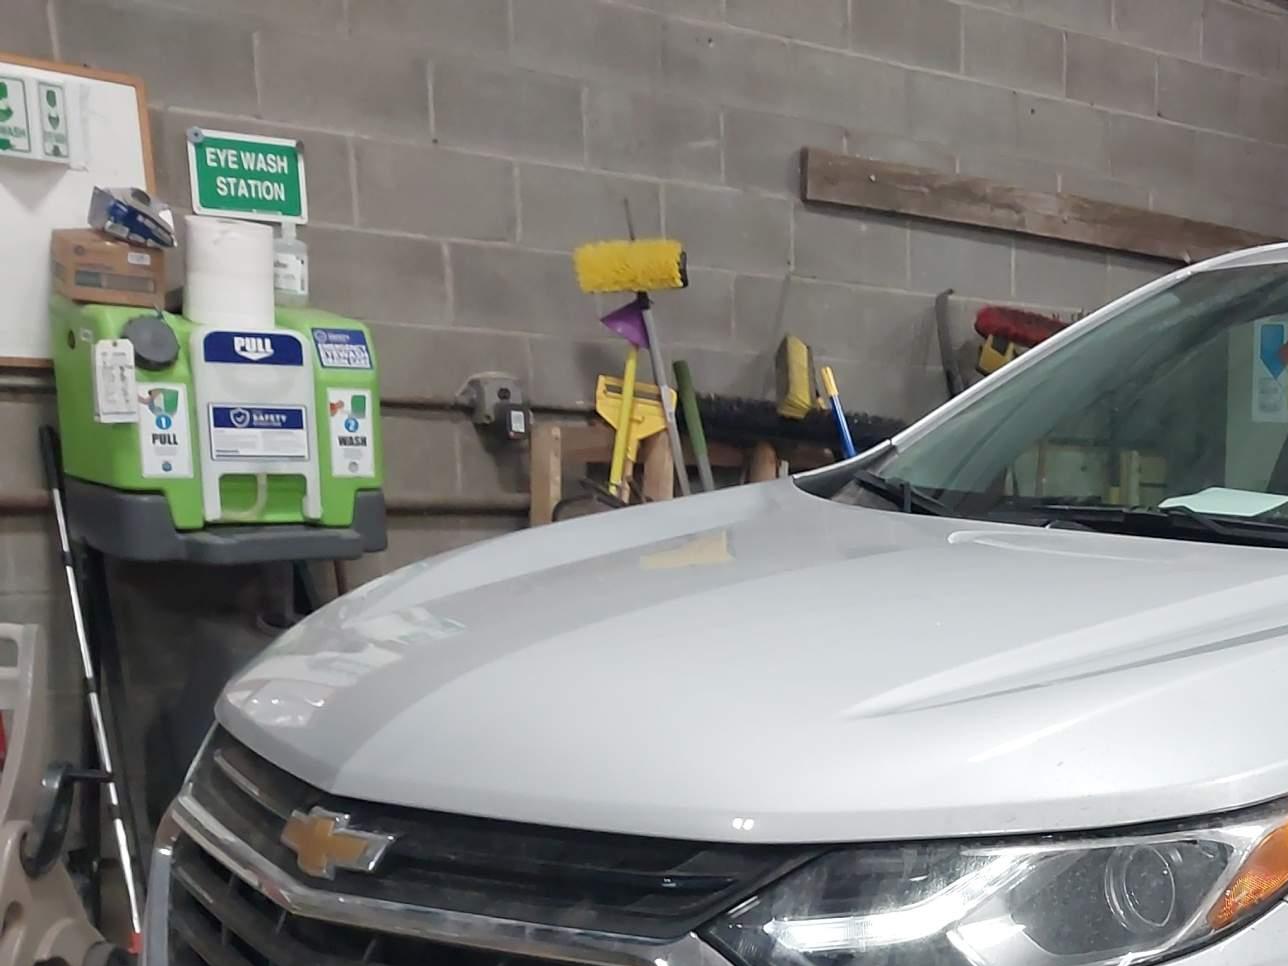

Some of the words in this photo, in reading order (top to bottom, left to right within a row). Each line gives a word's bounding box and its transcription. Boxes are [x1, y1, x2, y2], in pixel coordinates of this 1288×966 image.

[205, 147, 239, 169] EYE
[240, 150, 288, 175] WASH
[216, 176, 286, 202] STATION
[233, 336, 274, 353] PULL
[151, 432, 178, 446] PULL
[338, 435, 368, 447] WASH
